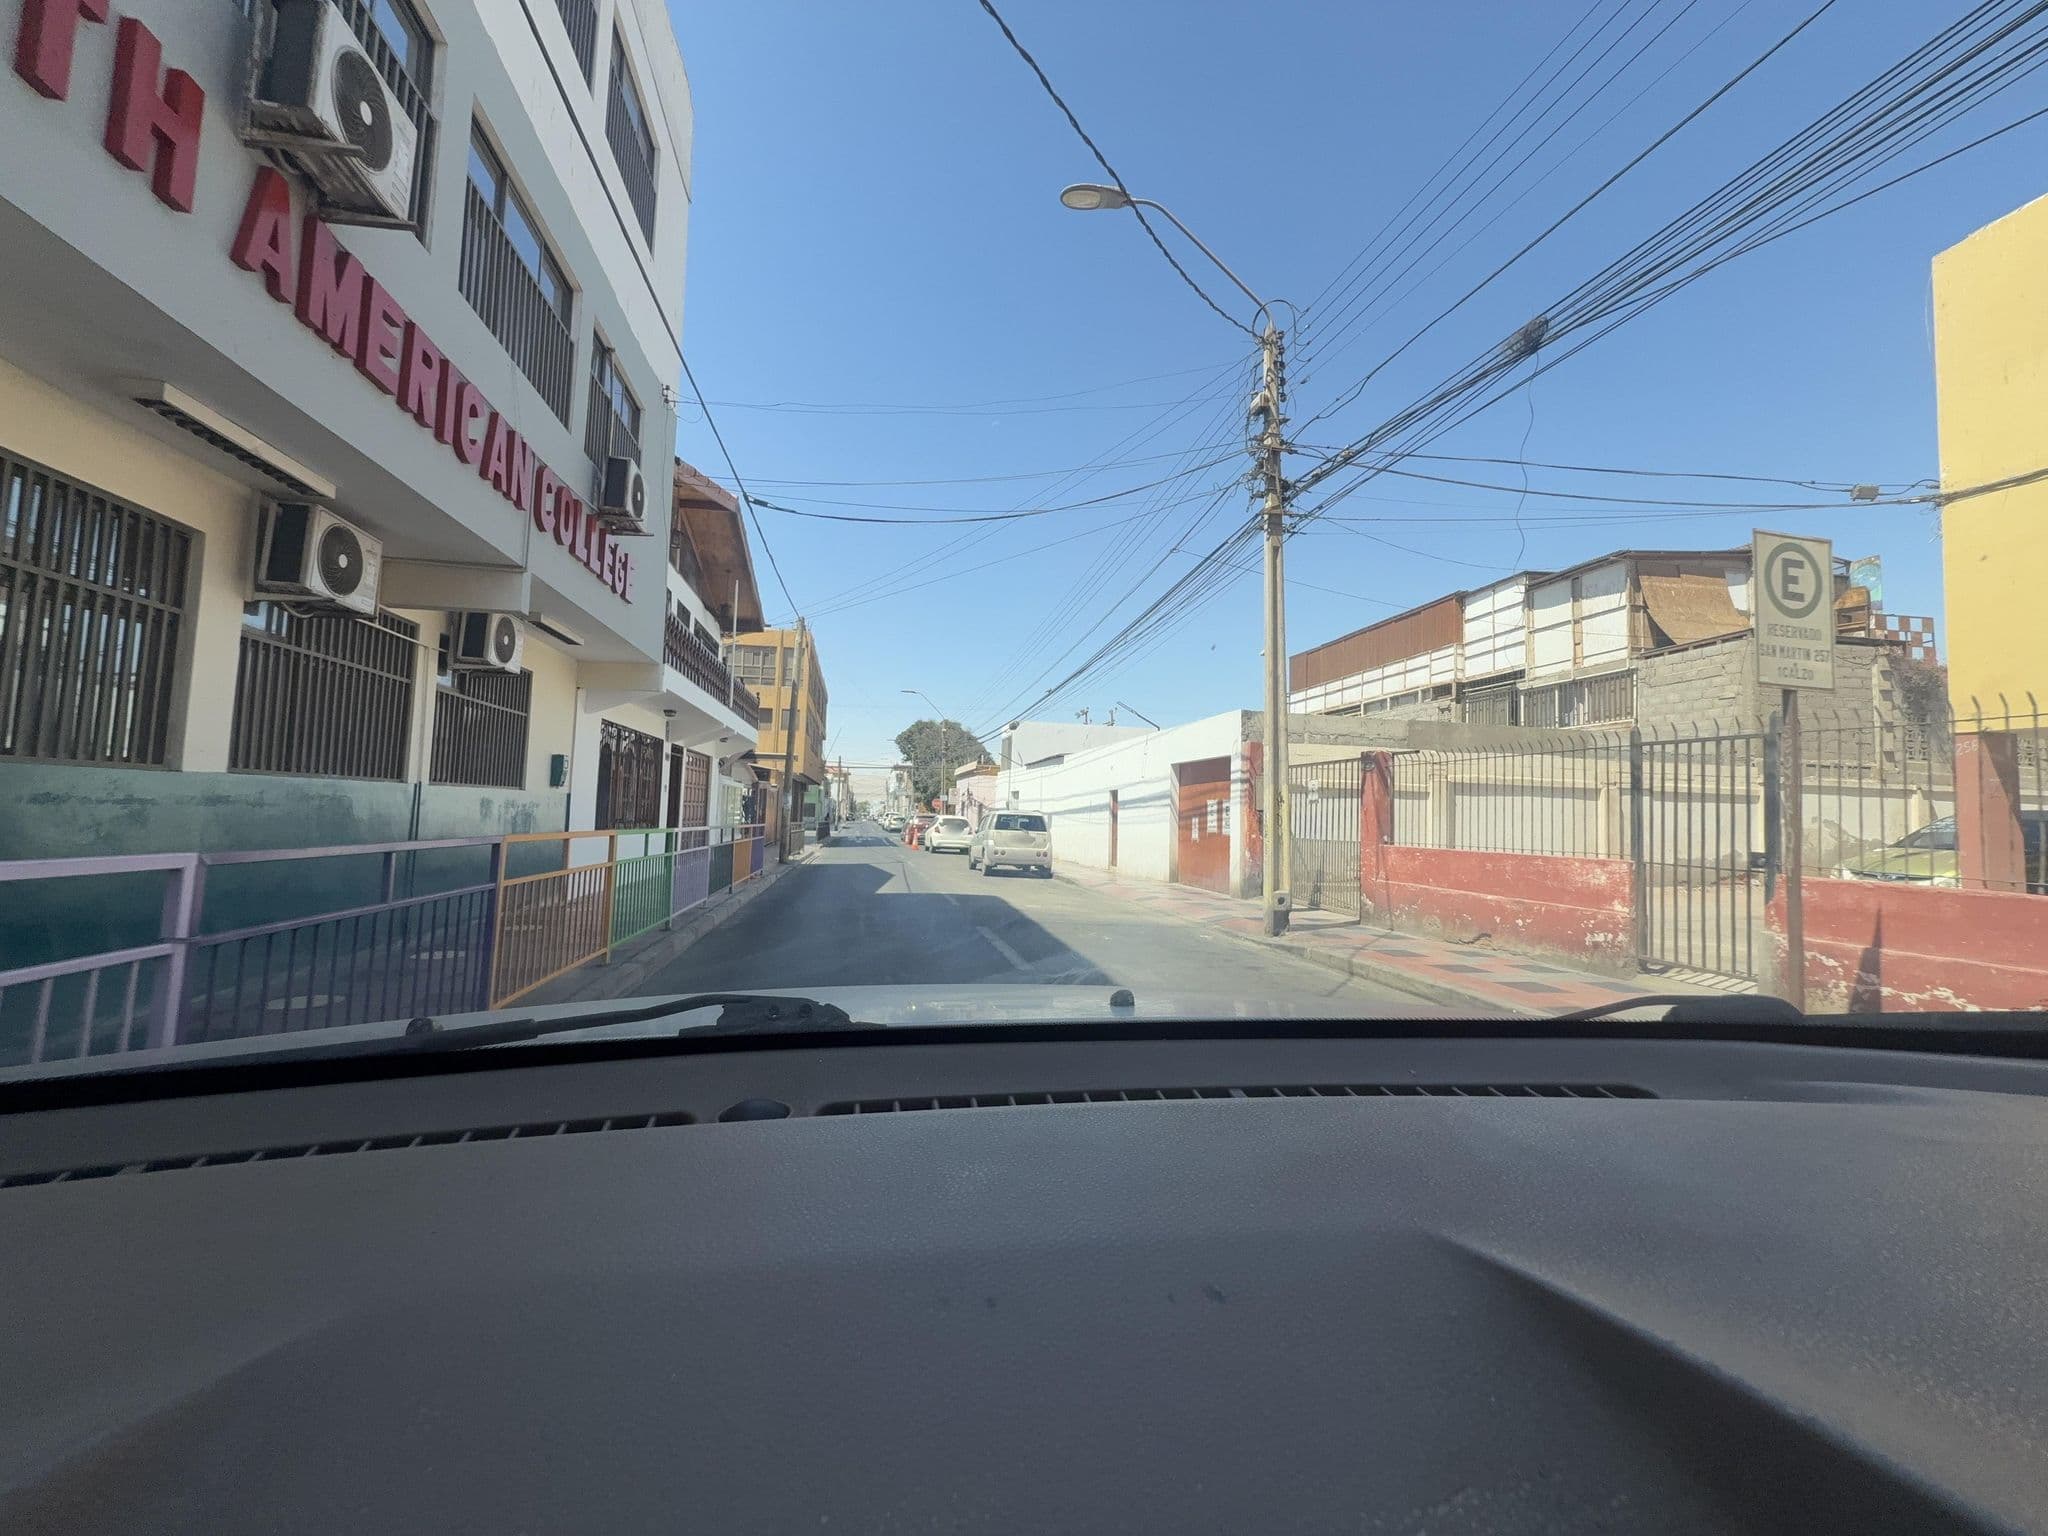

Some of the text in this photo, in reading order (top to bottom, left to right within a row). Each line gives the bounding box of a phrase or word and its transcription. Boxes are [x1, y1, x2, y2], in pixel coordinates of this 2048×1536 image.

[229, 165, 534, 511] AMERICAN
[533, 464, 637, 605] COLLEGE
[1782, 557, 1805, 602] E
[1767, 624, 1822, 641] RESERVADO
[1760, 644, 1776, 657] SAN
[1777, 645, 1811, 661] MARTIN
